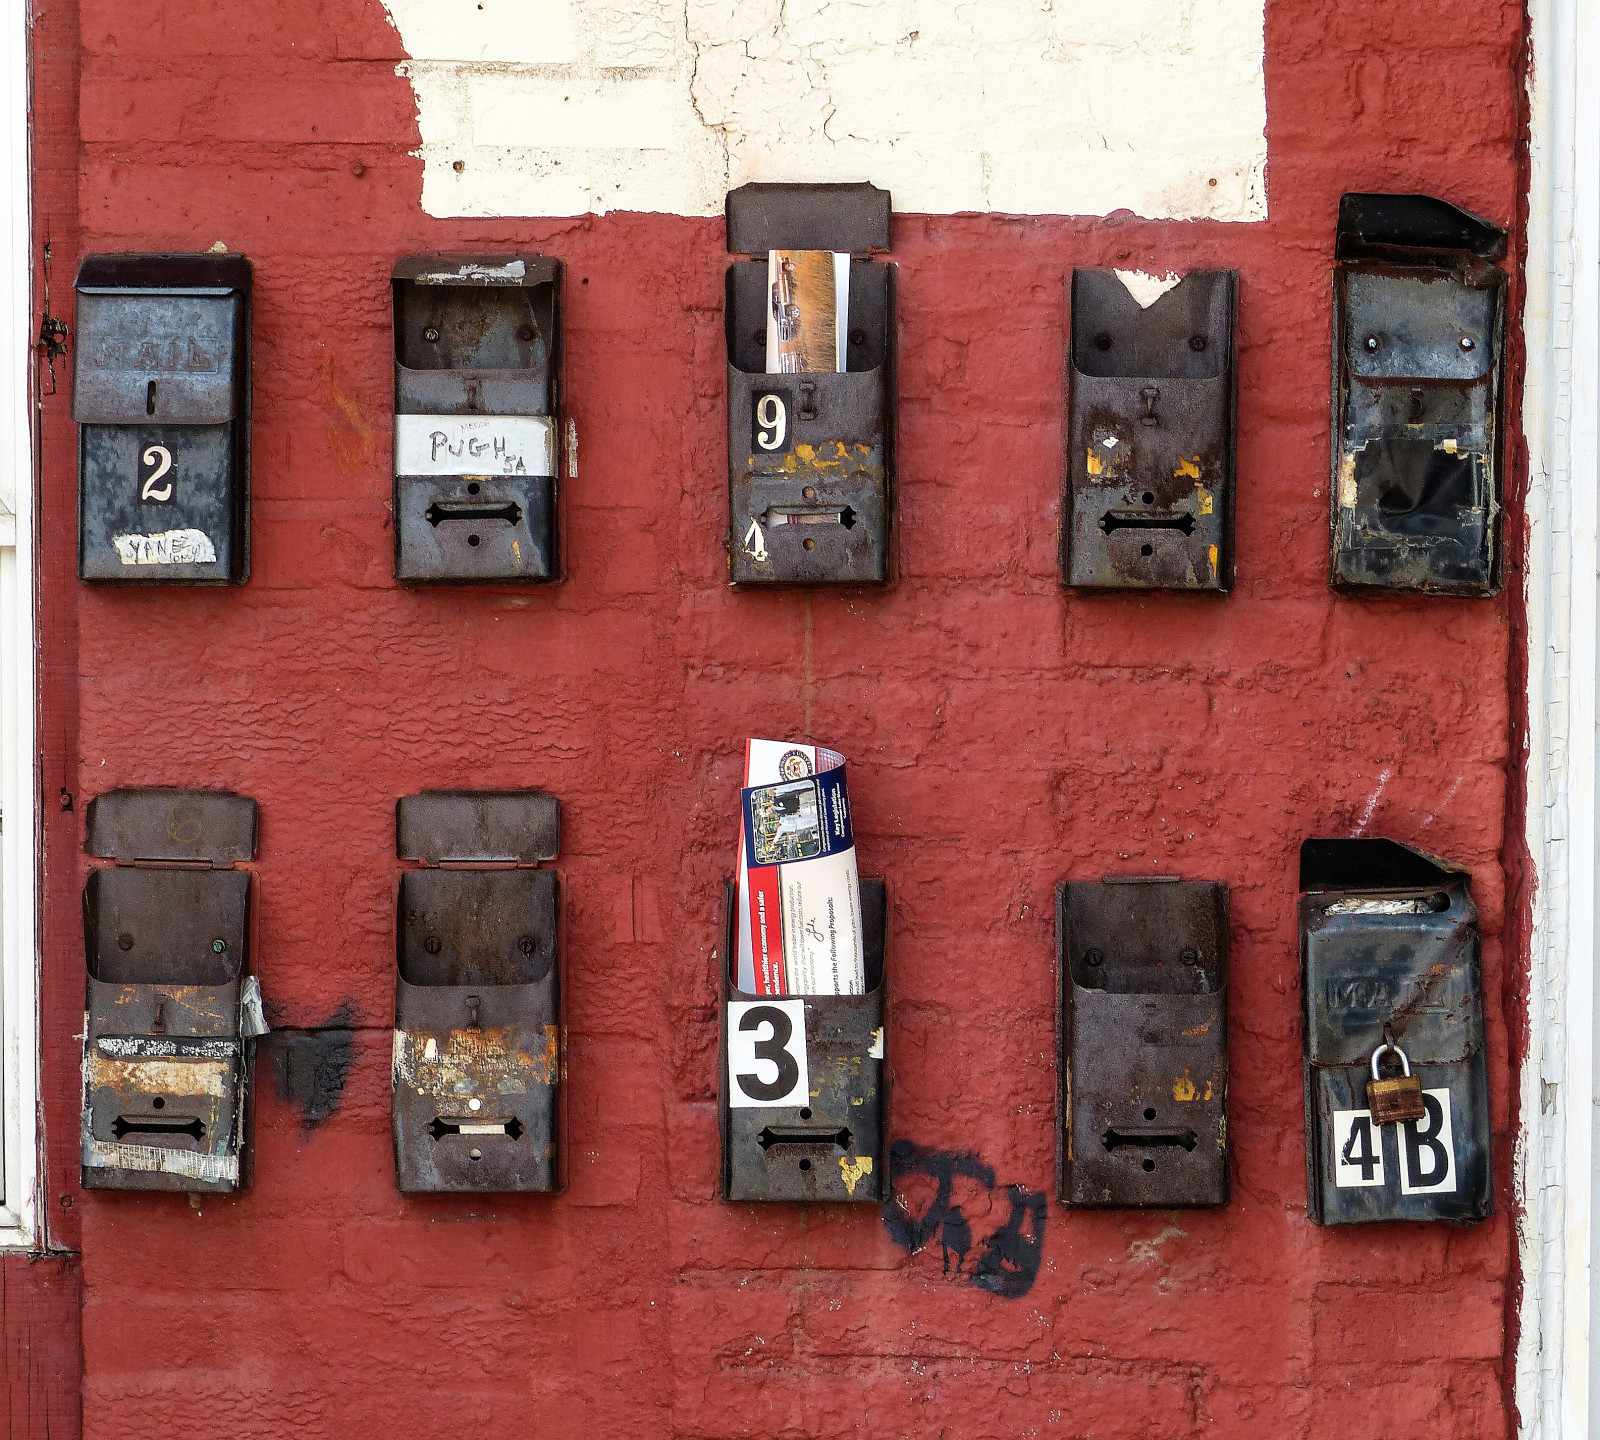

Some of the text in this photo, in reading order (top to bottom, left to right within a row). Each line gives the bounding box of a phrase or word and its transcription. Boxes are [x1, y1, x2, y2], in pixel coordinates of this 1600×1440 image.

[429, 431, 506, 461] PUGH
[757, 395, 787, 450] 9
[142, 446, 172, 501] 2
[742, 517, 769, 561] 4
[827, 897, 835, 929] Proposals:
[736, 1006, 799, 1101] 3
